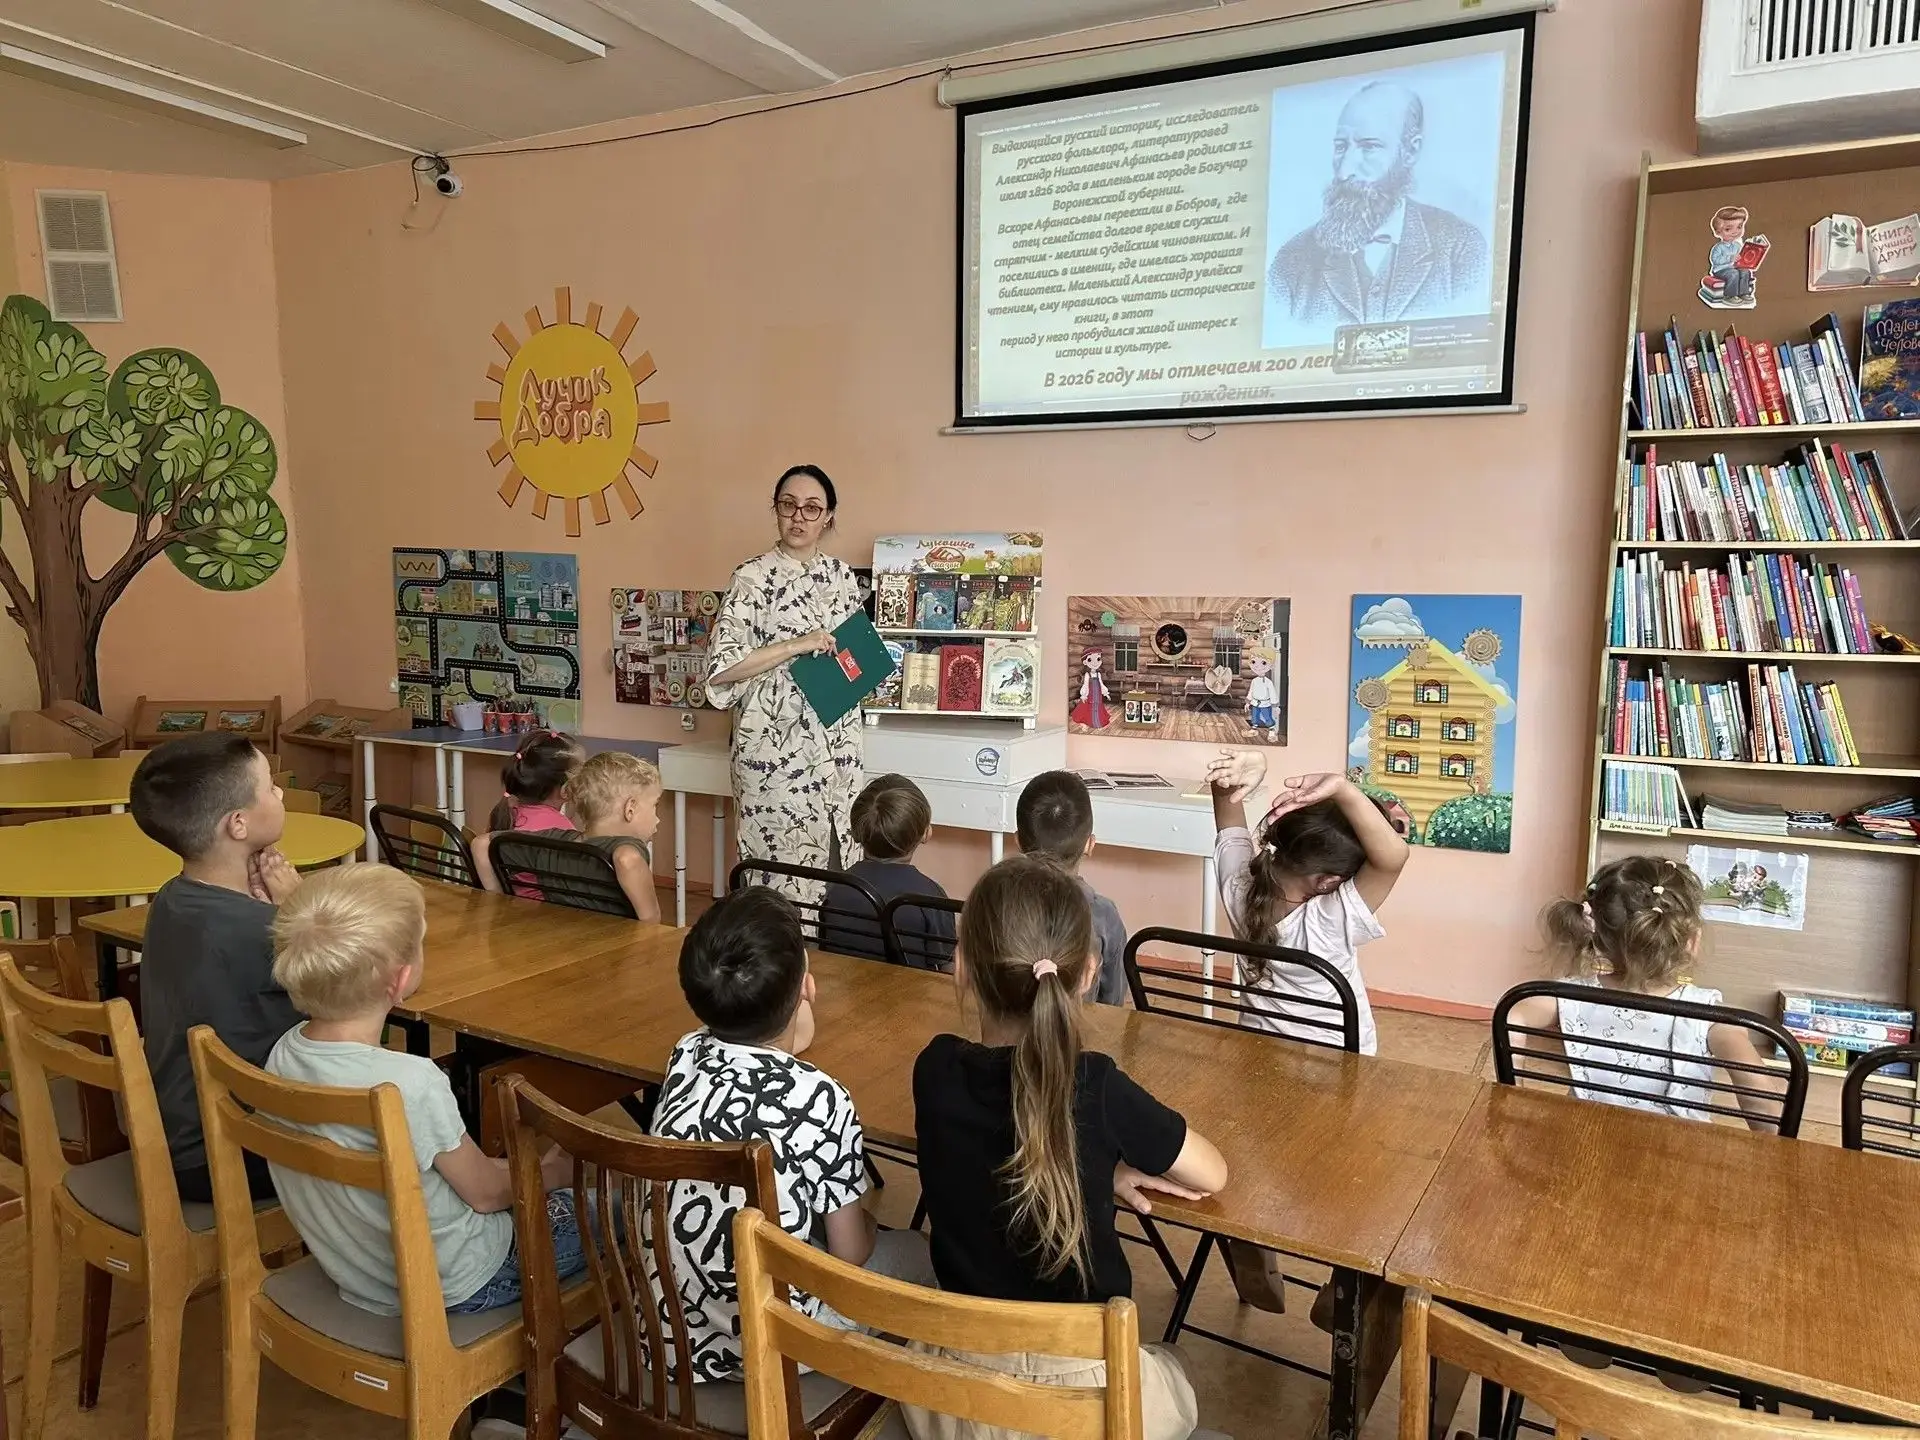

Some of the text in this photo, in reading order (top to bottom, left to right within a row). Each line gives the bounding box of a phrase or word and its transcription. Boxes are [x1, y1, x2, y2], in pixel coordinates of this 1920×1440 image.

[992, 134, 1062, 154] Выдающийся
[1063, 124, 1107, 146] русский
[1109, 119, 1162, 135] историк,
[1165, 103, 1260, 126] исследователь
[1016, 152, 1062, 170] русского
[1130, 123, 1229, 149] литературовед
[995, 165, 1052, 186] Александр
[1053, 159, 1120, 178] Николаевич
[1120, 149, 1185, 169] Афанасьев
[1186, 143, 1236, 161] родился
[999, 159, 1248, 202] июля 1826 года в маленьком городе Богучар
[997, 192, 1248, 235] Вскоре Афанасьевы переехали в Бобров, где
[1052, 185, 1184, 212] Воронежской губернии.
[994, 253, 1046, 269] стряпчим
[1054, 247, 1098, 260] мелким
[1100, 239, 1159, 257] судейским
[1161, 230, 1238, 247] чиновником.
[1239, 226, 1251, 238] И
[1012, 213, 1229, 249] отец семейства долгое время служил
[998, 264, 1243, 299] библиотека. Маленький Александр увлёкся
[999, 247, 1243, 283] поселились в имении, где имелась хорошая
[987, 281, 1256, 316] чтением, ему нравилось читать исторические
[1074, 309, 1154, 324] книги, в этот
[1000, 317, 1238, 348] период у него пробудился живой интерес к
[1055, 340, 1171, 359] истории и культуре.
[519, 366, 611, 410] Лучик
[1044, 372, 1055, 387] В
[1058, 369, 1094, 386] 2026
[1097, 366, 1135, 387] году
[1136, 366, 1164, 381] мы
[1167, 358, 1261, 379] отмечаем
[1264, 357, 1296, 372] 200
[1179, 384, 1275, 407] рождения.
[510, 401, 611, 449] Добра
